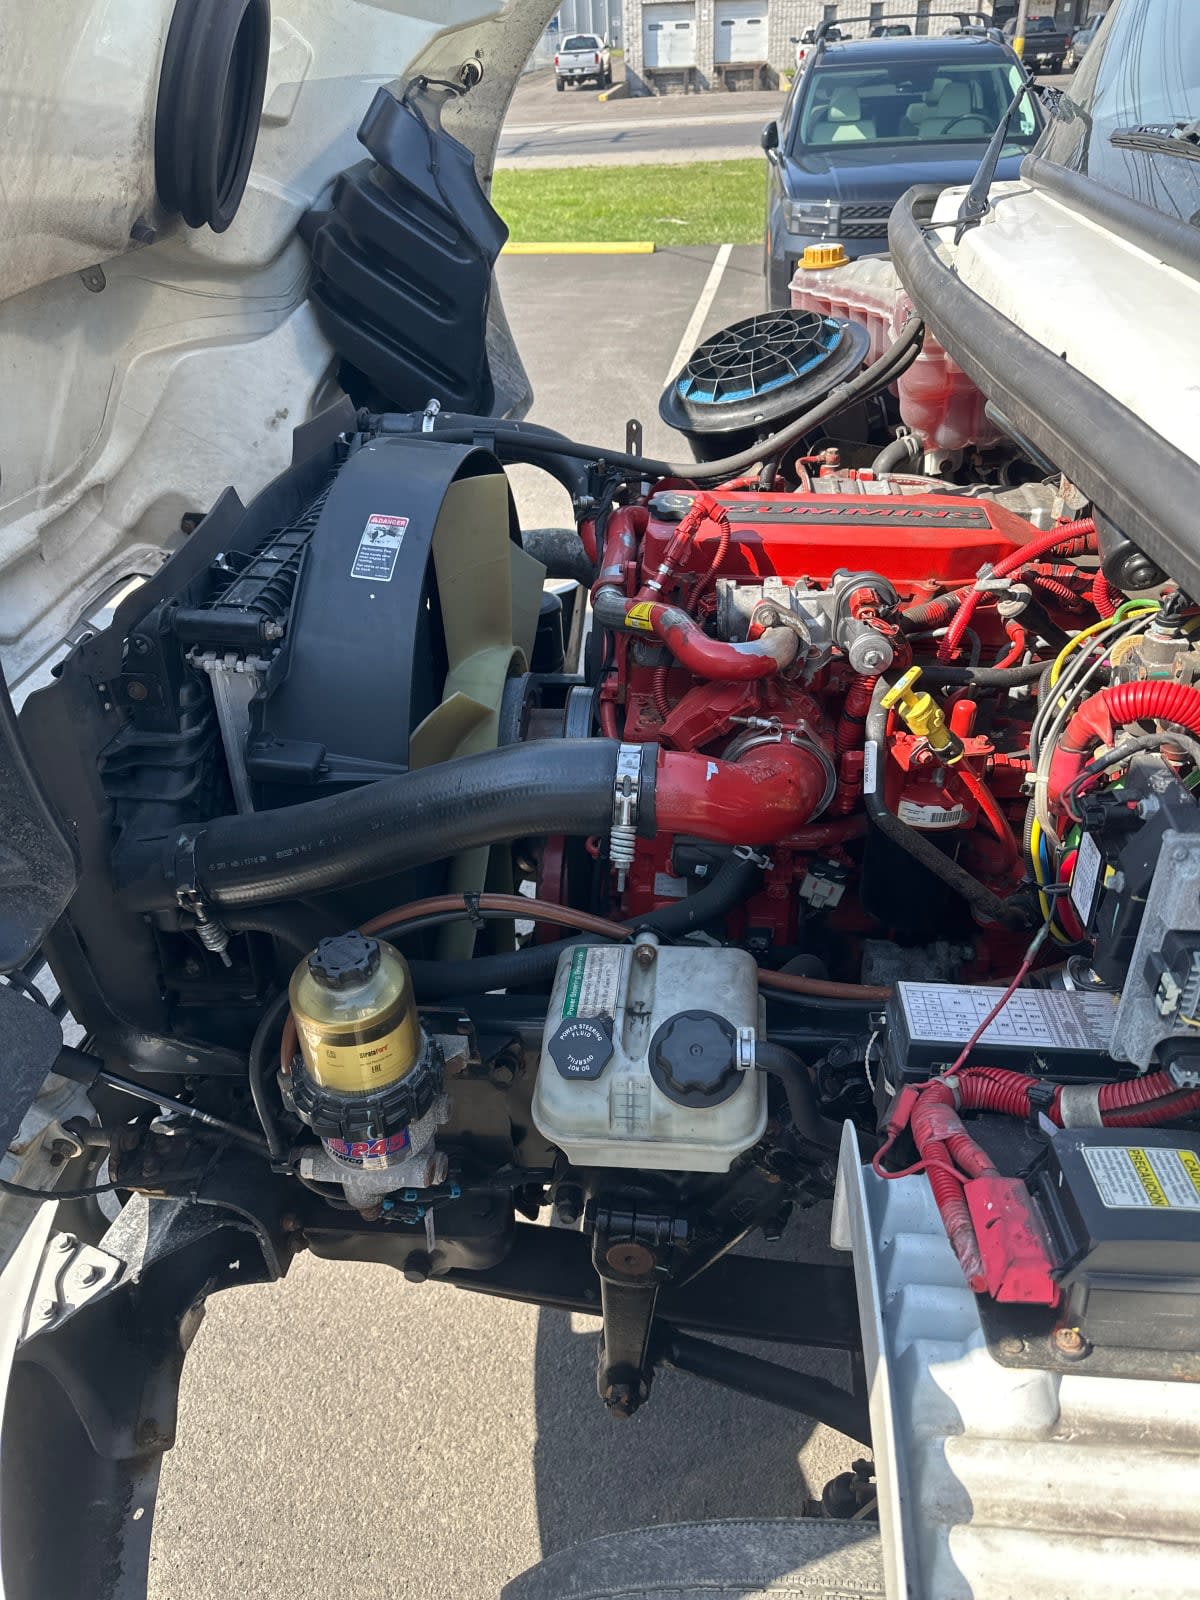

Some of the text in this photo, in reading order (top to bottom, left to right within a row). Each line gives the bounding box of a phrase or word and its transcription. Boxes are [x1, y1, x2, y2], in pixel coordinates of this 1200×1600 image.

[724, 504, 985, 519] CUMMINS
[377, 518, 406, 526] DANGER
[559, 1023, 603, 1042] POWER STEERING
[571, 1030, 592, 1038] FLUID
[567, 1054, 594, 1066] OVERFILL
[567, 1064, 590, 1072] DO NOT
[351, 1133, 405, 1158] 245
[332, 1150, 364, 1165] DAVCO
[1129, 1149, 1166, 1206] PRECAUCION
